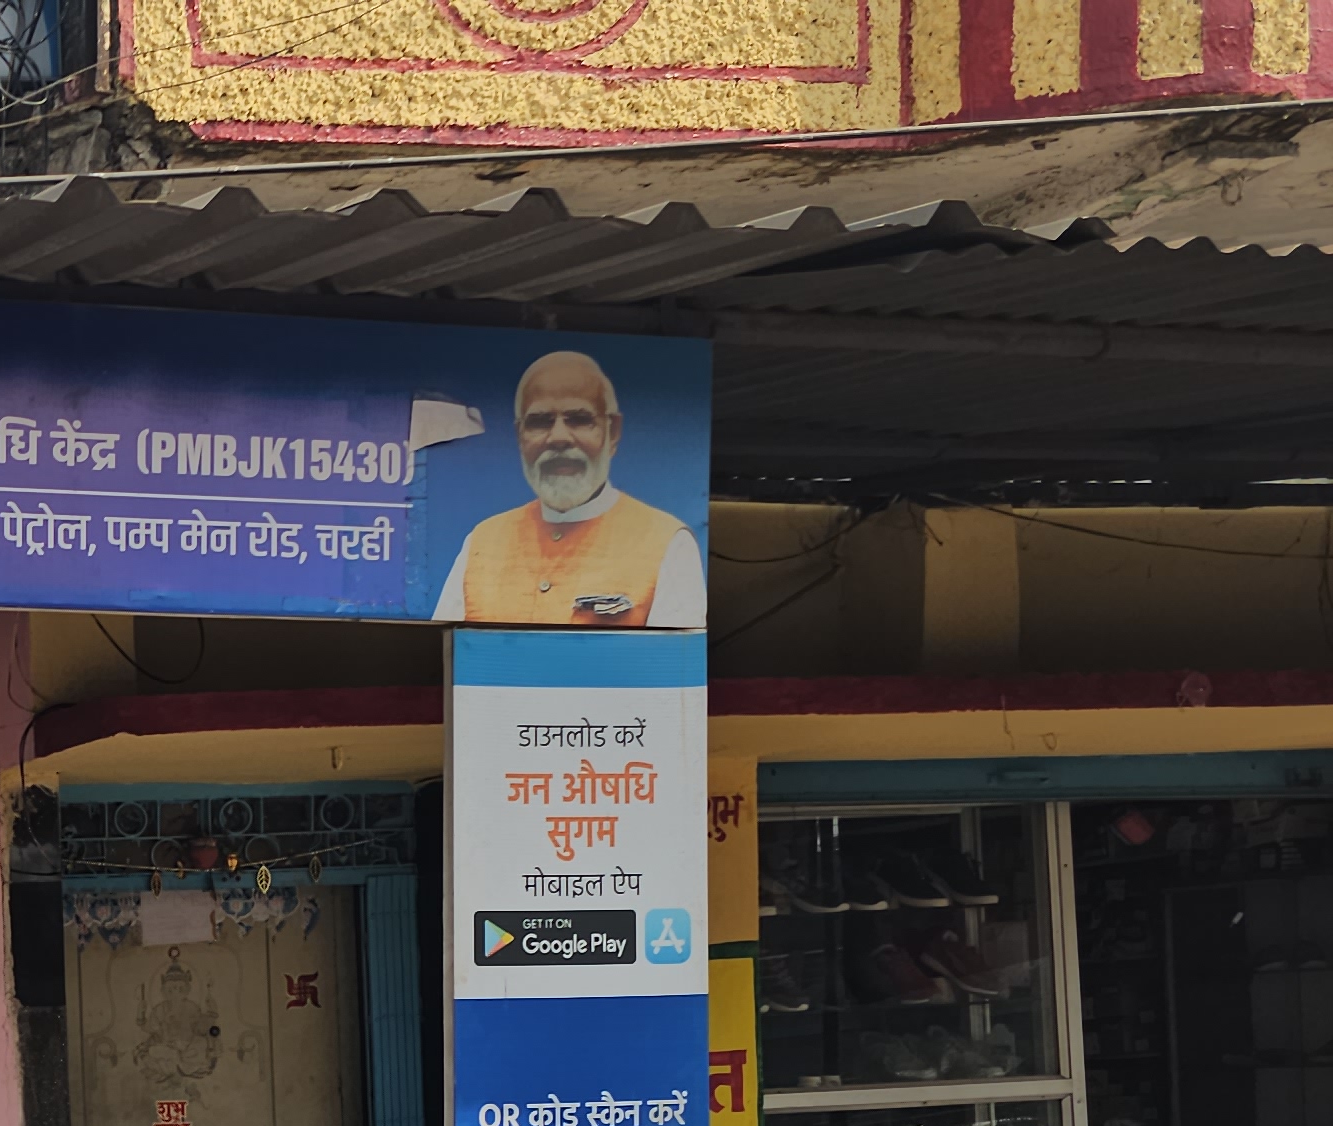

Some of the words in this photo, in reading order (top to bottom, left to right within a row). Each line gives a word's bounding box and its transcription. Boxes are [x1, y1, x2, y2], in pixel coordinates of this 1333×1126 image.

[50, 419, 120, 470] केंद्र
[137, 428, 414, 486] (PMBJK15430)
[0, 501, 96, 557] पेट्रोल,
[103, 516, 174, 554] पम्प
[178, 509, 241, 556] मेन
[245, 512, 308, 564] रोड,
[314, 516, 395, 561] चरही
[517, 717, 608, 748] डाउनलोड
[613, 717, 647, 748] करें
[505, 773, 553, 805] जन
[562, 759, 658, 805] औषधि
[546, 816, 619, 862] सुगम
[522, 866, 605, 898] मोबाइल
[610, 866, 642, 896] ऐप
[522, 918, 543, 930] GET
[544, 918, 554, 930] IT
[555, 918, 572, 930] ON
[522, 933, 587, 960] Google
[590, 932, 627, 958] Play
[157, 1101, 188, 1122] शुभ
[646, 1089, 688, 1126] करें
